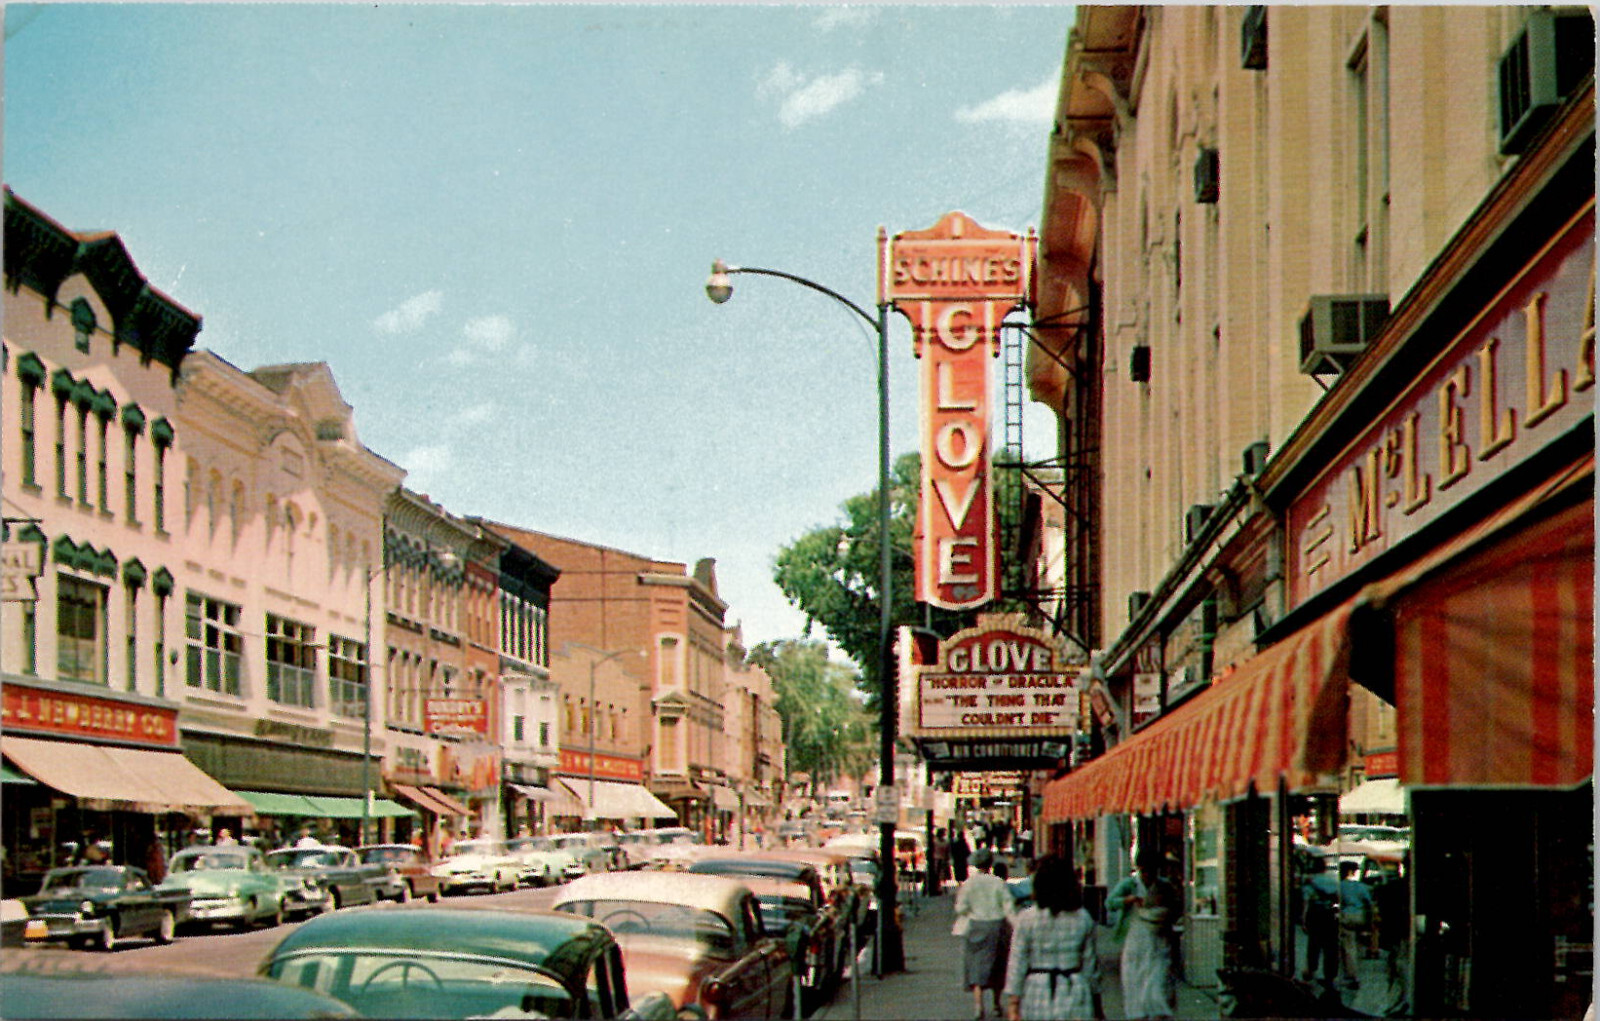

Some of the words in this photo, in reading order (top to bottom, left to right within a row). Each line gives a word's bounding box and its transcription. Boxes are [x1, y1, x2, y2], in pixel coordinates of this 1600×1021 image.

[932, 304, 983, 586] GLOVE
[949, 639, 1051, 673] GLOVE
[986, 694, 1026, 707] THING
[1033, 693, 1066, 706] THAT
